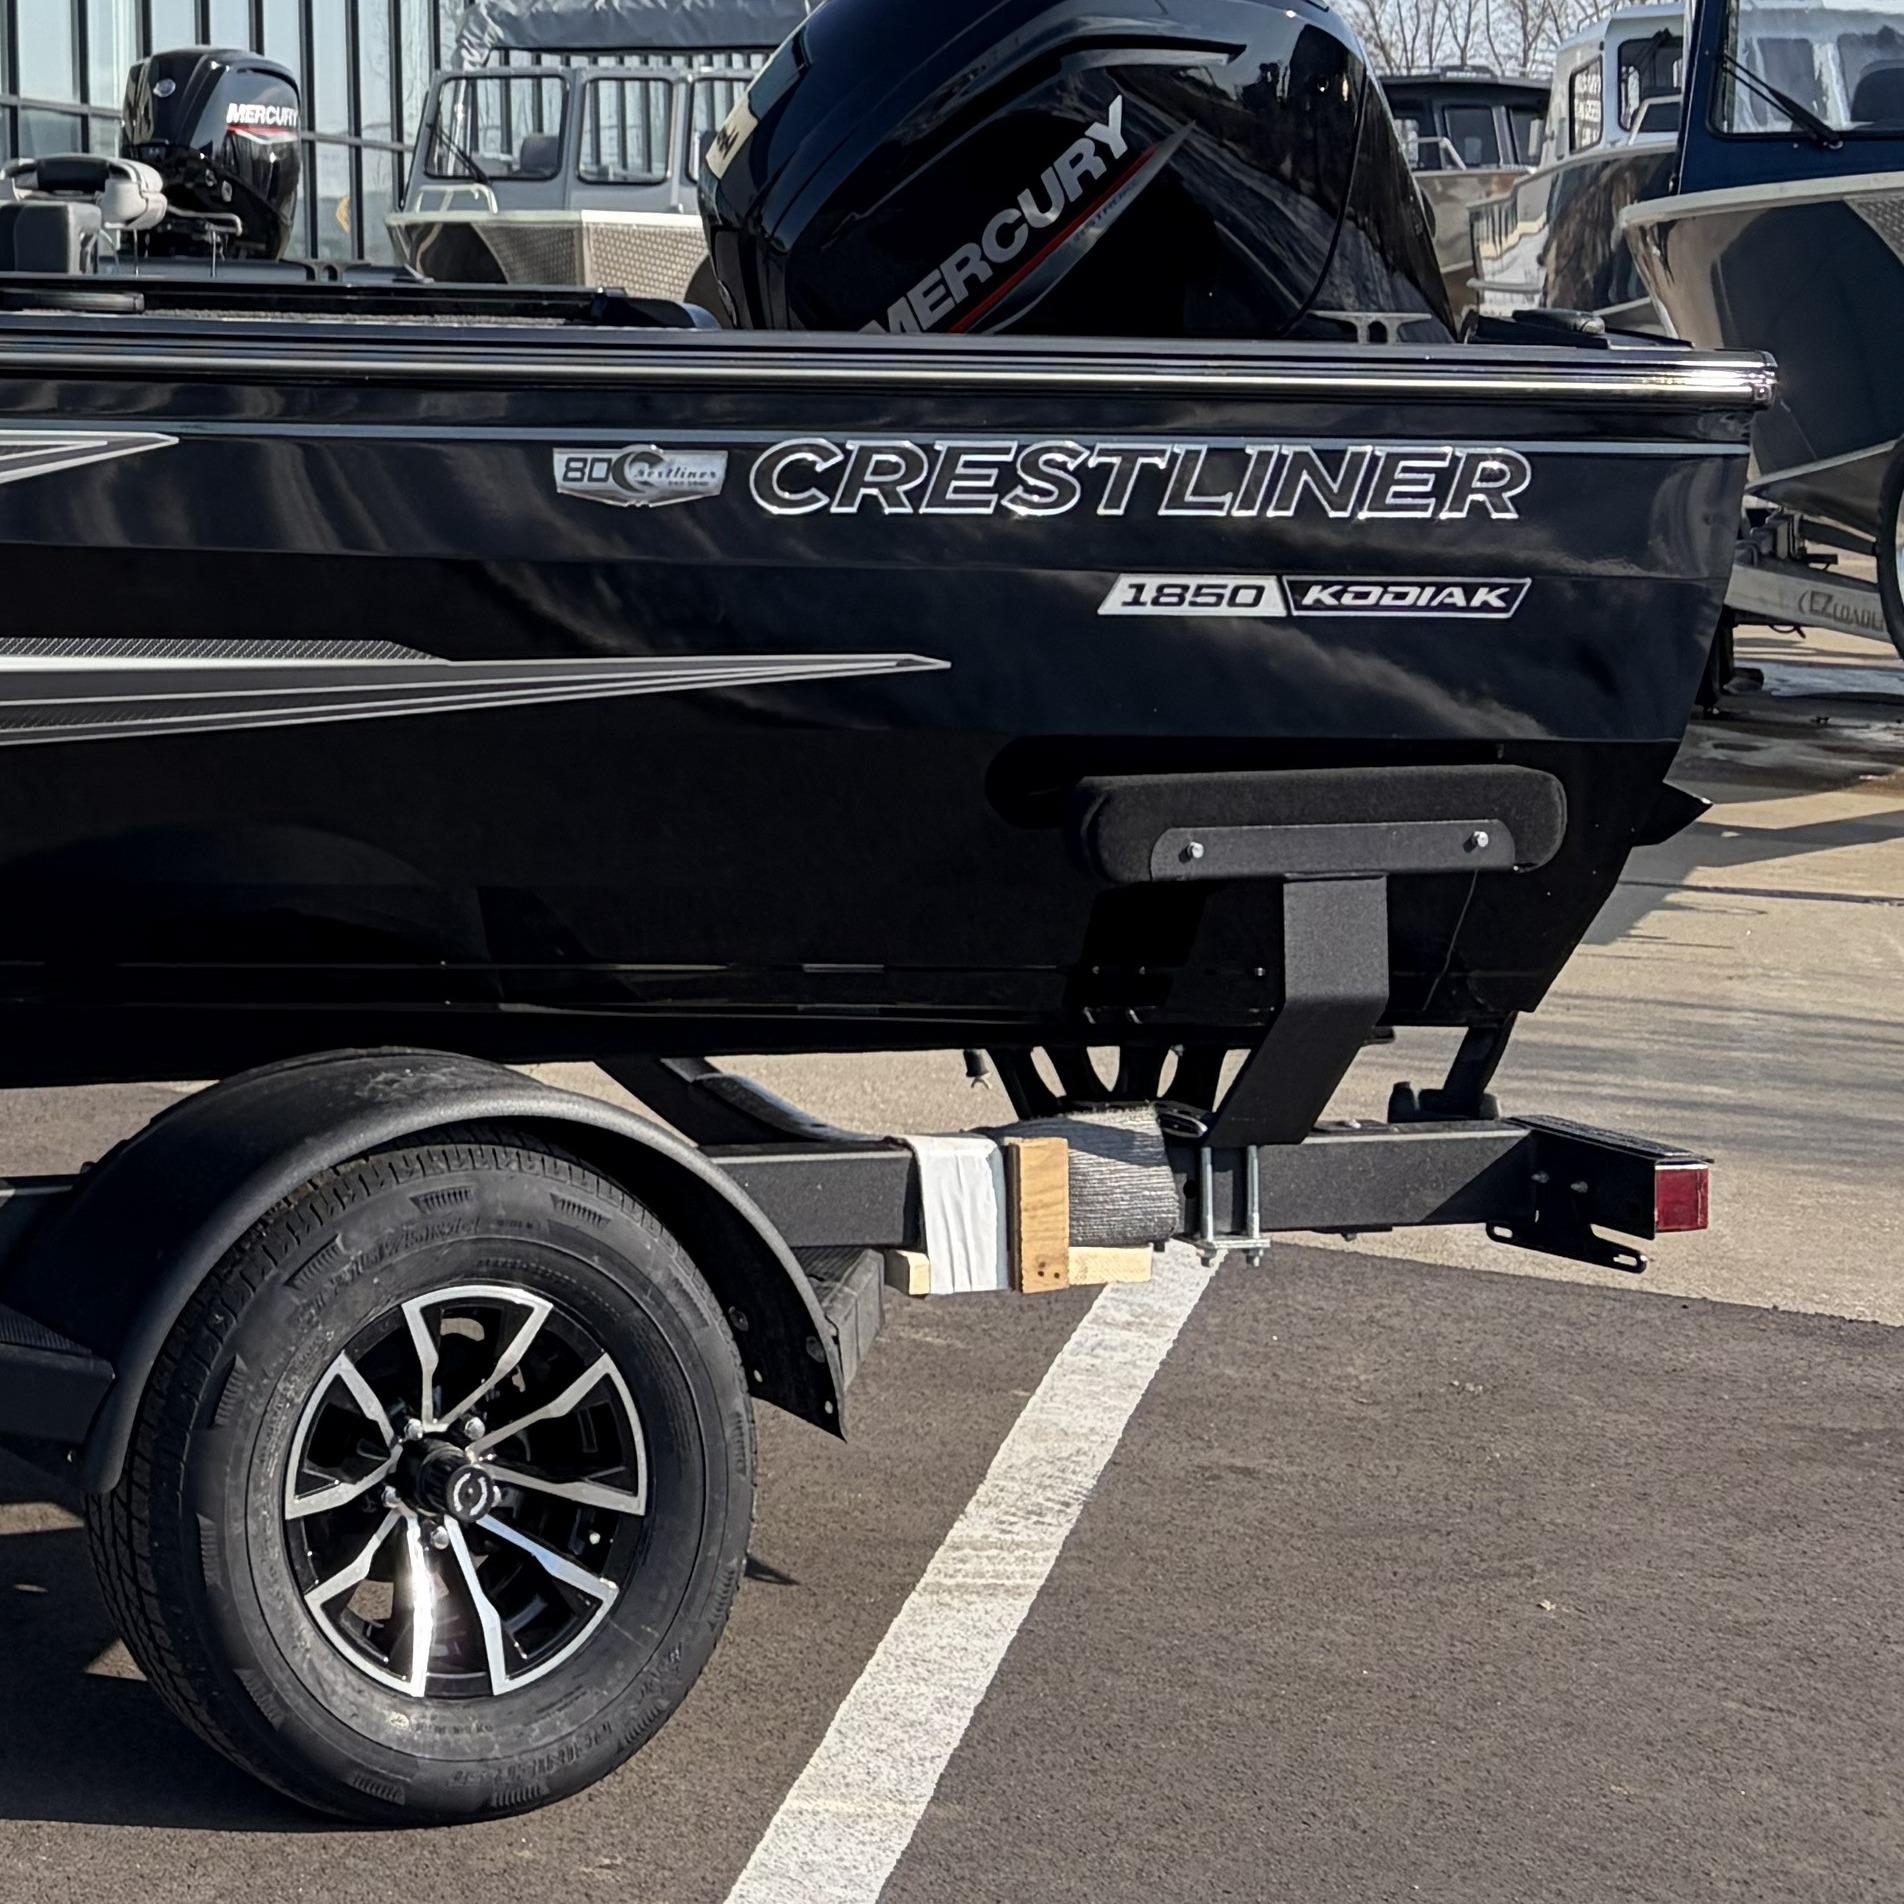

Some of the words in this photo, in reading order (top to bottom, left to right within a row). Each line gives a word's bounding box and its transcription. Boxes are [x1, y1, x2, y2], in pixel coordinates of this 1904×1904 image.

[226, 102, 299, 128] MERCURY
[562, 457, 613, 483] 80
[749, 438, 1533, 520] CRESTLINER
[1121, 583, 1267, 609] 1850
[1301, 585, 1511, 611] KODIAK
